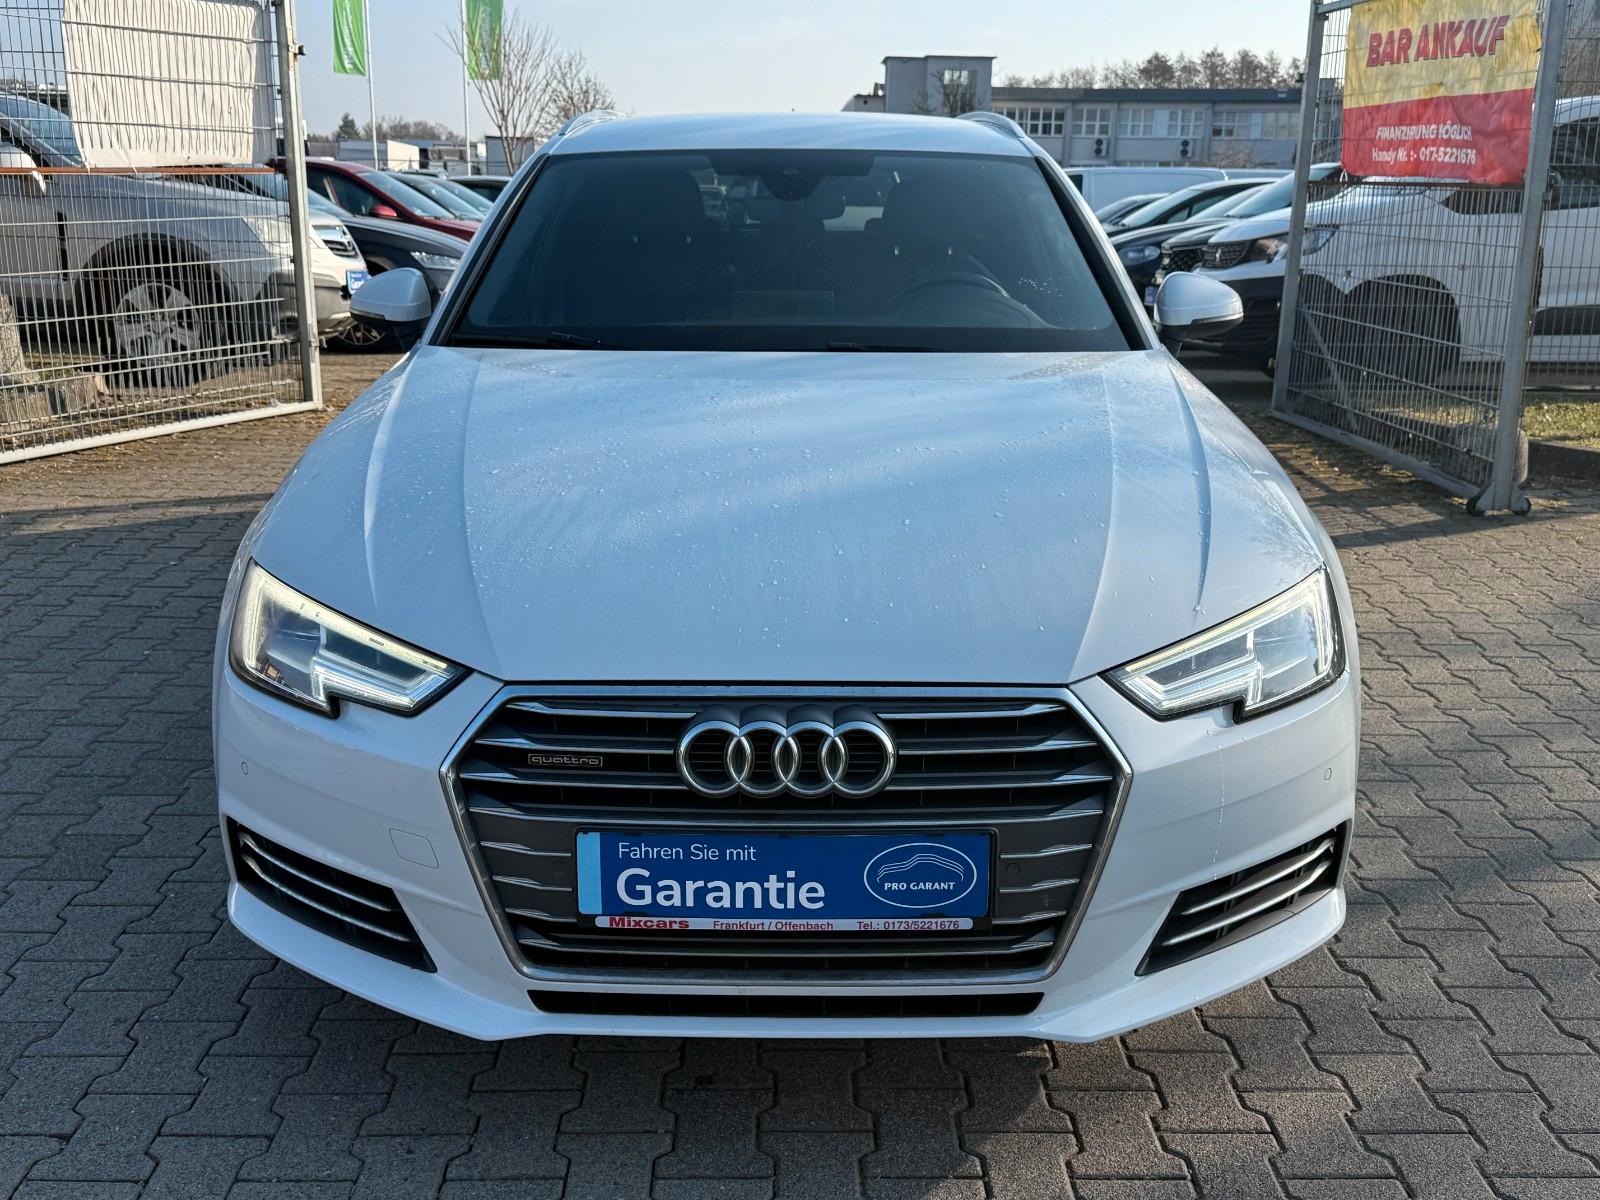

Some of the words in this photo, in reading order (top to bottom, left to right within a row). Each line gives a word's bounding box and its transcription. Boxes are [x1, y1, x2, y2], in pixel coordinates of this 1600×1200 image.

[1366, 28, 1413, 67] BAR
[1414, 15, 1510, 62] ANKAUF
[1372, 147, 1396, 165] Handy
[531, 756, 599, 766] quattro
[618, 842, 683, 860] Fahren
[690, 843, 719, 861] Sie
[726, 845, 757, 861] mit
[616, 867, 826, 910] Garantie
[884, 881, 907, 891] PRO
[909, 881, 956, 891] GARANT
[609, 916, 690, 929] Mixcars
[712, 920, 766, 931] Frankfurt
[774, 921, 834, 931] Offenbach
[857, 920, 880, 931] Tel.:
[883, 920, 960, 931] 0173/5221676
